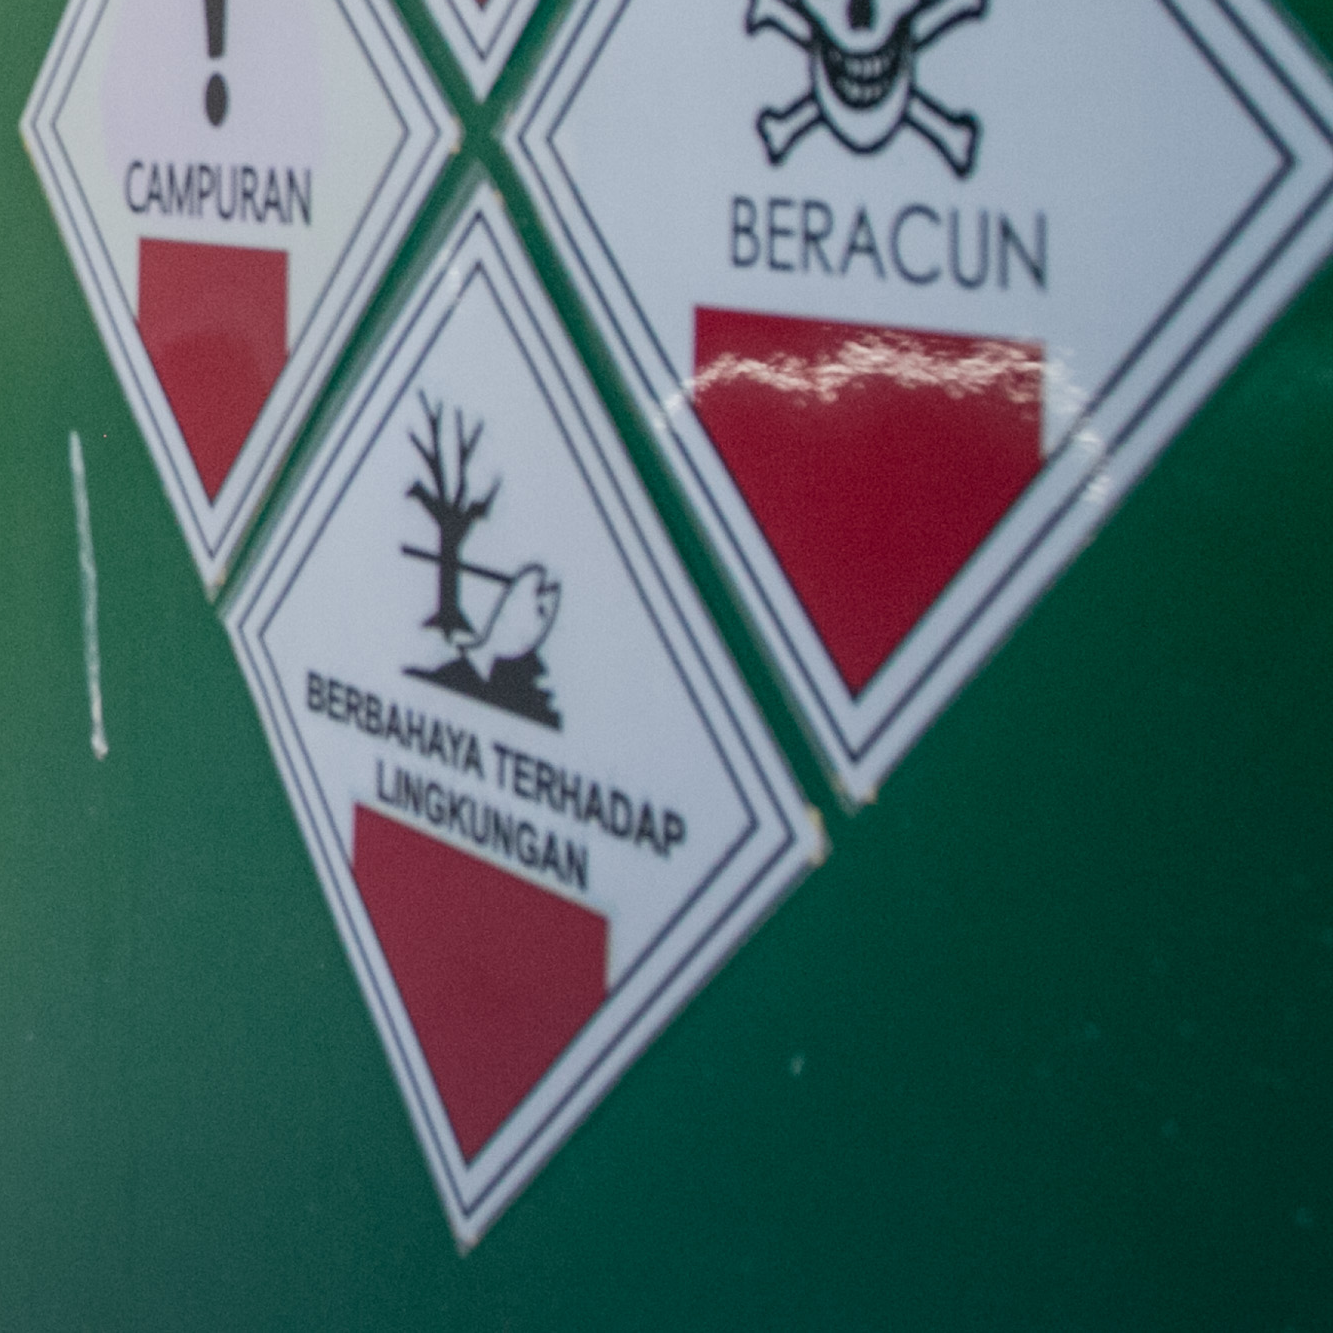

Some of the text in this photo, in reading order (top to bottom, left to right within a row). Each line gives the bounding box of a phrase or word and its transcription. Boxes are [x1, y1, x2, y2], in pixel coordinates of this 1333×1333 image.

[124, 160, 311, 226] CAMPURAN
[729, 195, 1047, 293] BERACUN
[307, 670, 685, 858] BERBAHAYA TERHADAP
[375, 759, 589, 891] LINGKUNGAN
